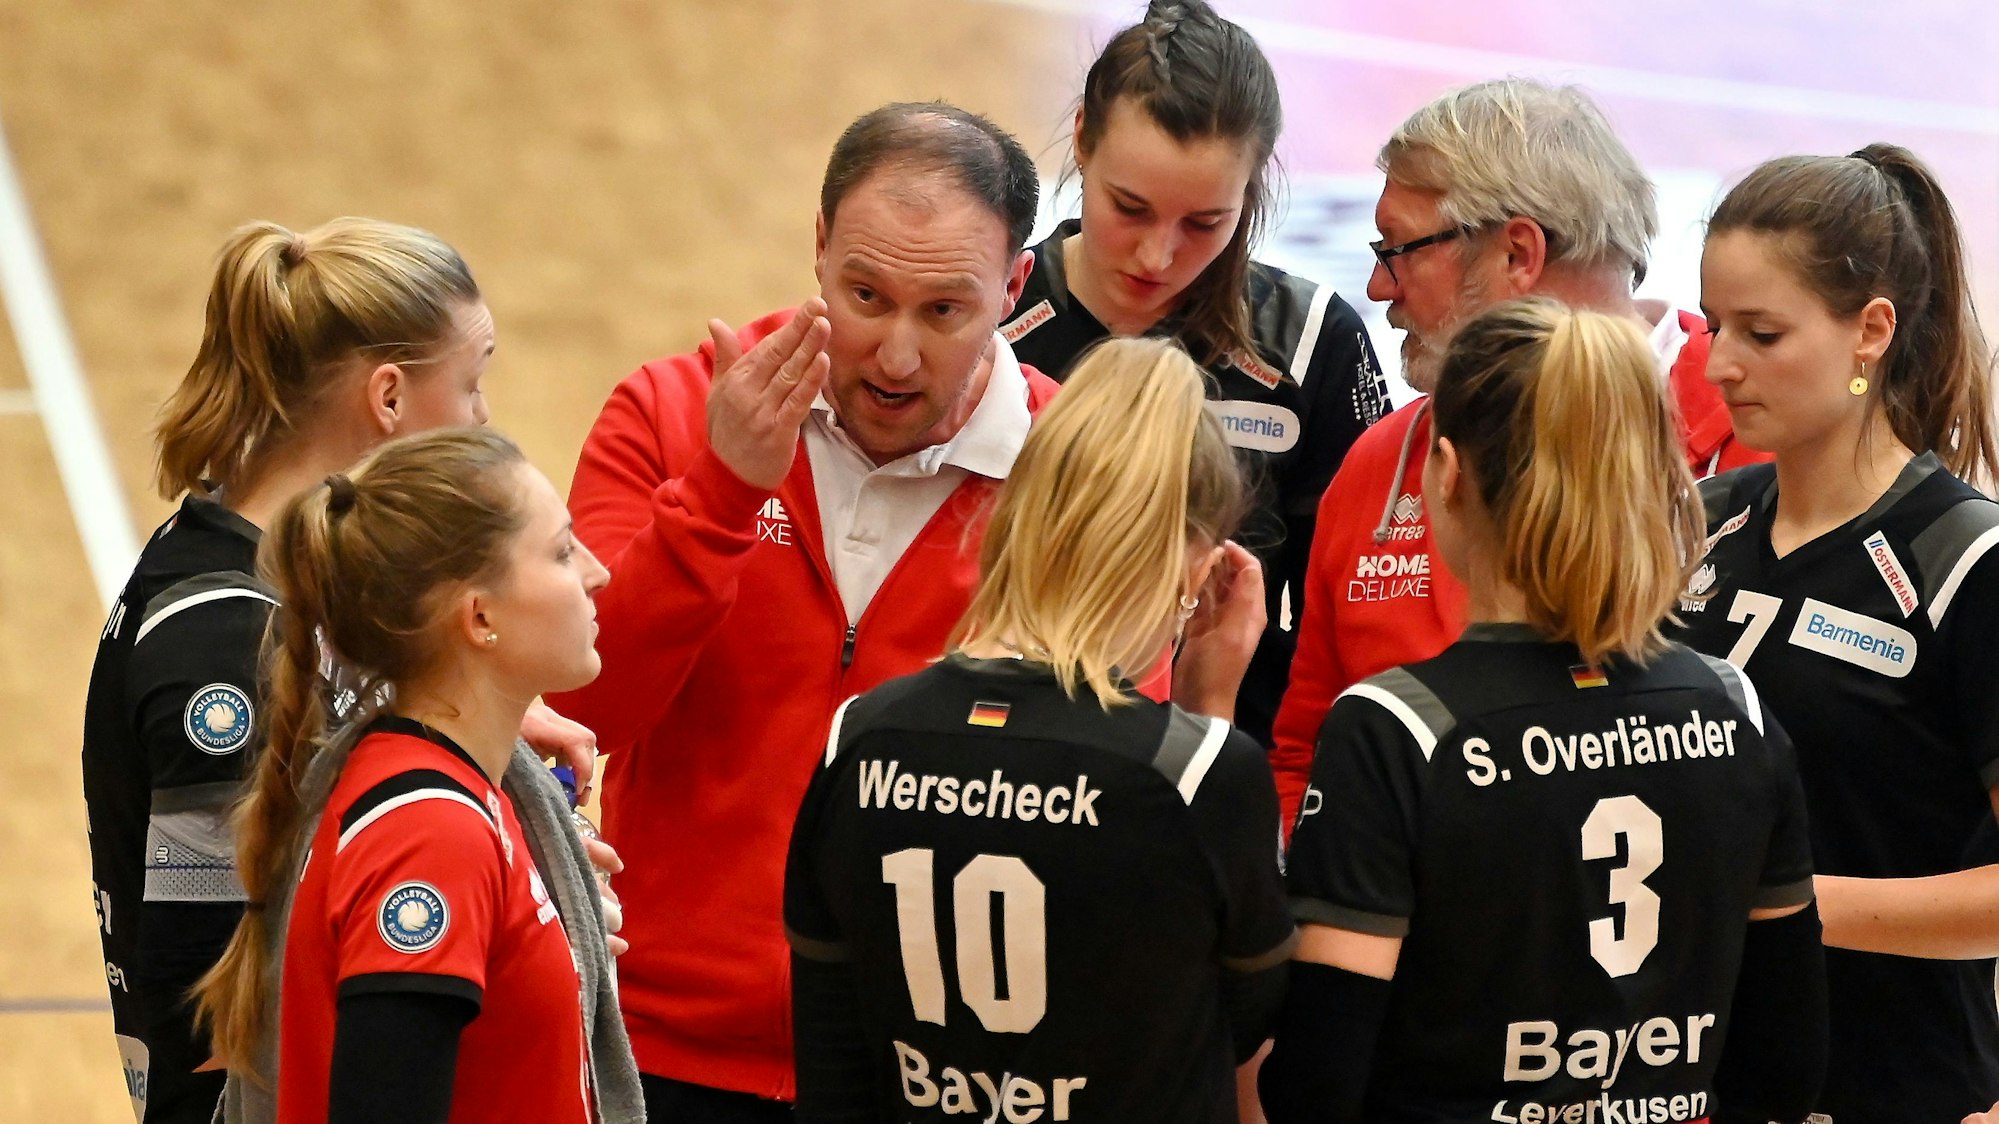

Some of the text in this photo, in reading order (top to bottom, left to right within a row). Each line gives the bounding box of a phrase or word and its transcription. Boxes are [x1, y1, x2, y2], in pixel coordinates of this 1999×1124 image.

[1003, 307, 1052, 341] RMANN
[1220, 416, 1285, 439] menia
[1356, 554, 1430, 578] HOME
[1874, 547, 1914, 613] OSTERMANN
[1347, 576, 1431, 602] DELUXE
[1727, 590, 1783, 670] 7
[1807, 613, 1905, 664] Barmenia
[193, 692, 244, 717] VOLLEYBALL
[196, 724, 246, 746] BUNDESLIGA
[1462, 709, 1737, 787] S. Overländer
[858, 759, 1103, 827] Werscheck
[388, 889, 440, 914] VOLLEYBALL
[1581, 794, 1664, 979] 3
[387, 922, 438, 944] BUNDESLIGA
[881, 847, 1047, 1034] 10
[1503, 1013, 1716, 1090] Bayer
[892, 1040, 1088, 1124] Bayer
[1491, 1090, 1708, 1124] Leverkusen
